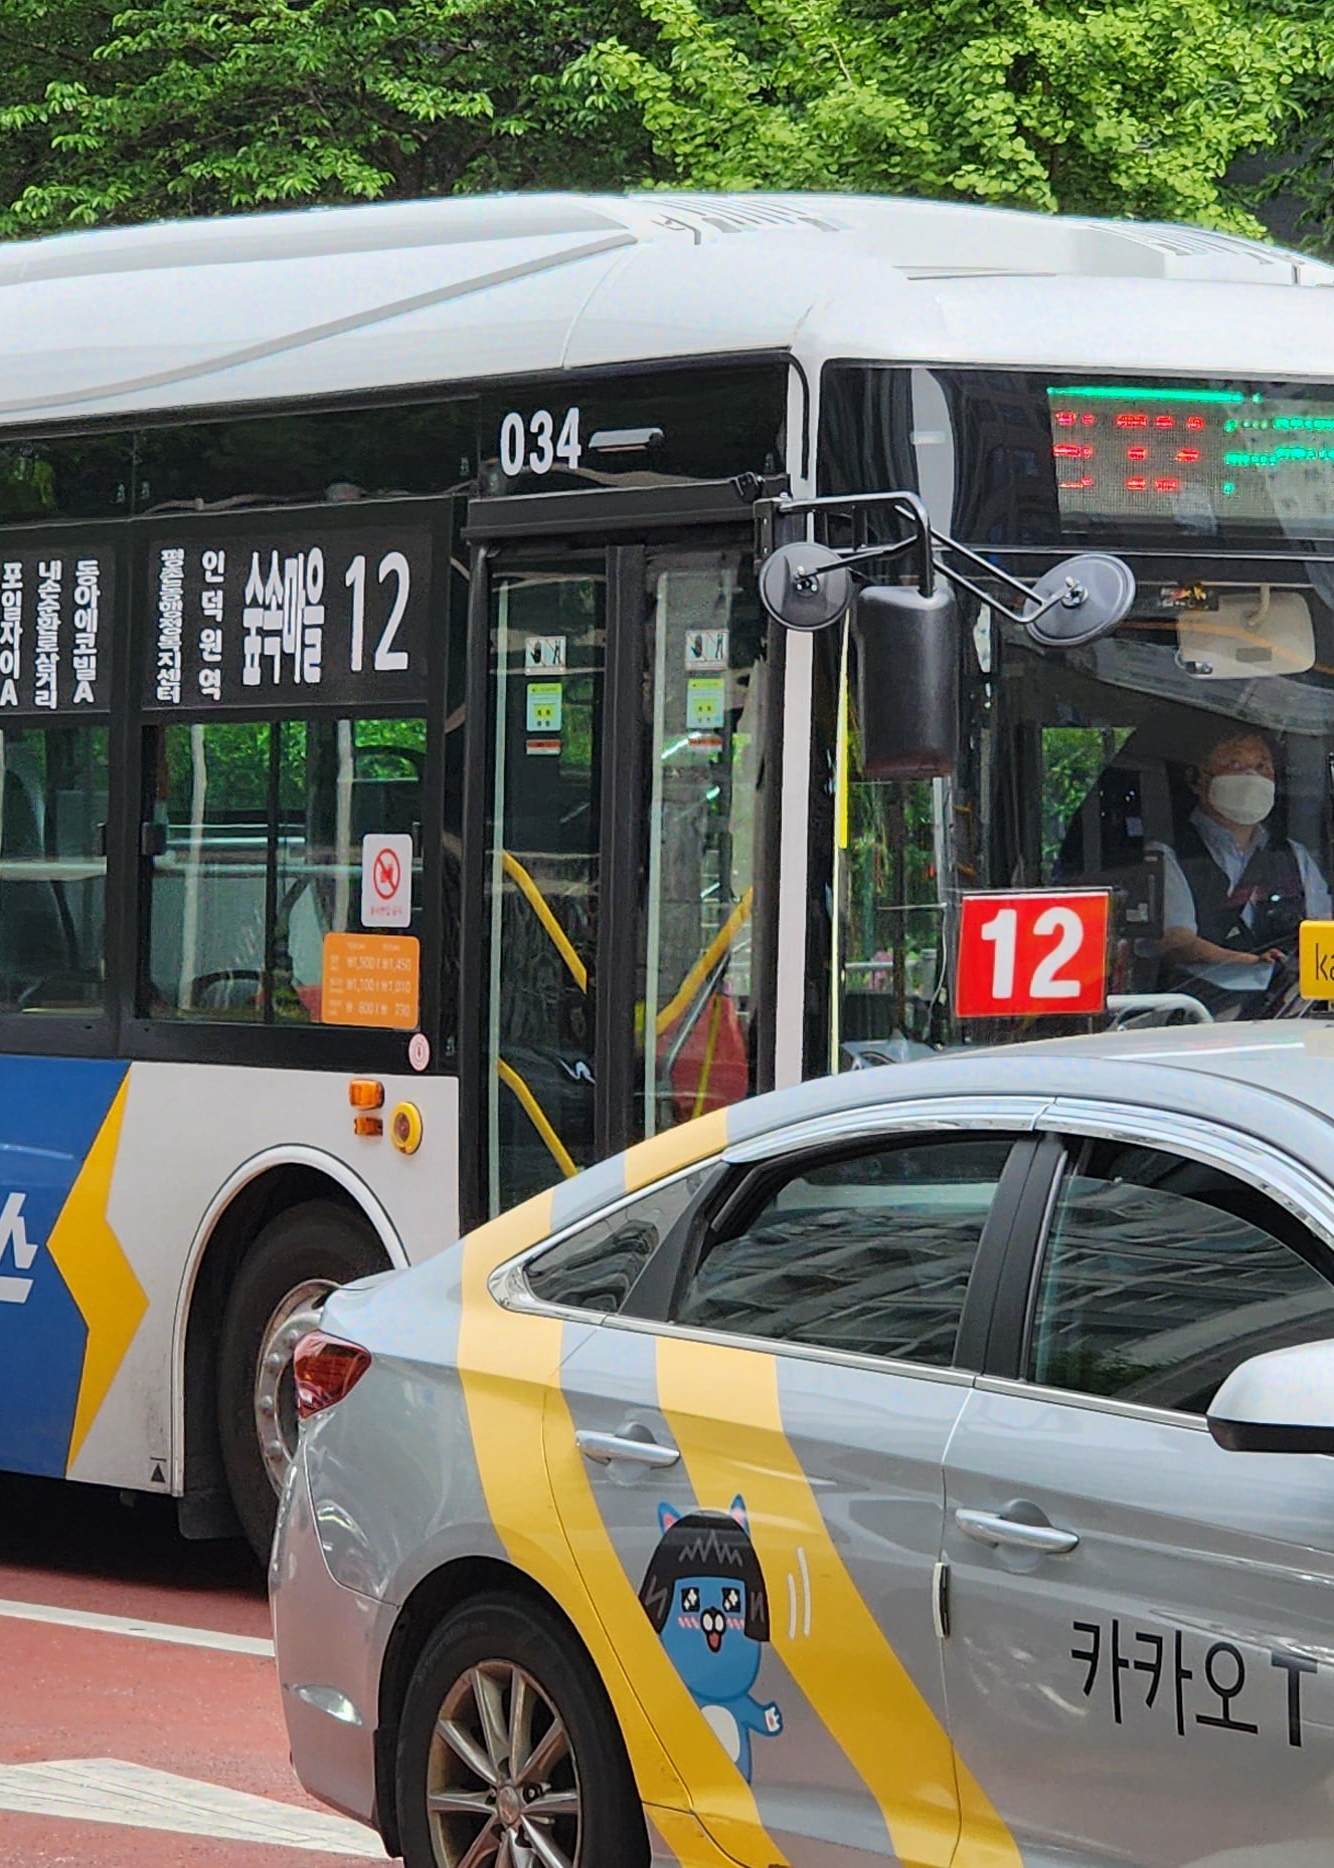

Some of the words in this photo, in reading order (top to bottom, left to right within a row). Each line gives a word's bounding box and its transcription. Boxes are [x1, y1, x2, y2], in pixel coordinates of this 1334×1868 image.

[500, 407, 582, 476] 034
[34, 559, 62, 709] 내손순환로삼거리
[73, 559, 101, 703] 동아에코빌A
[198, 550, 225, 700] 인덕원역
[242, 546, 325, 686] 숲속마을
[344, 551, 411, 672] 12
[980, 906, 1084, 999] 12
